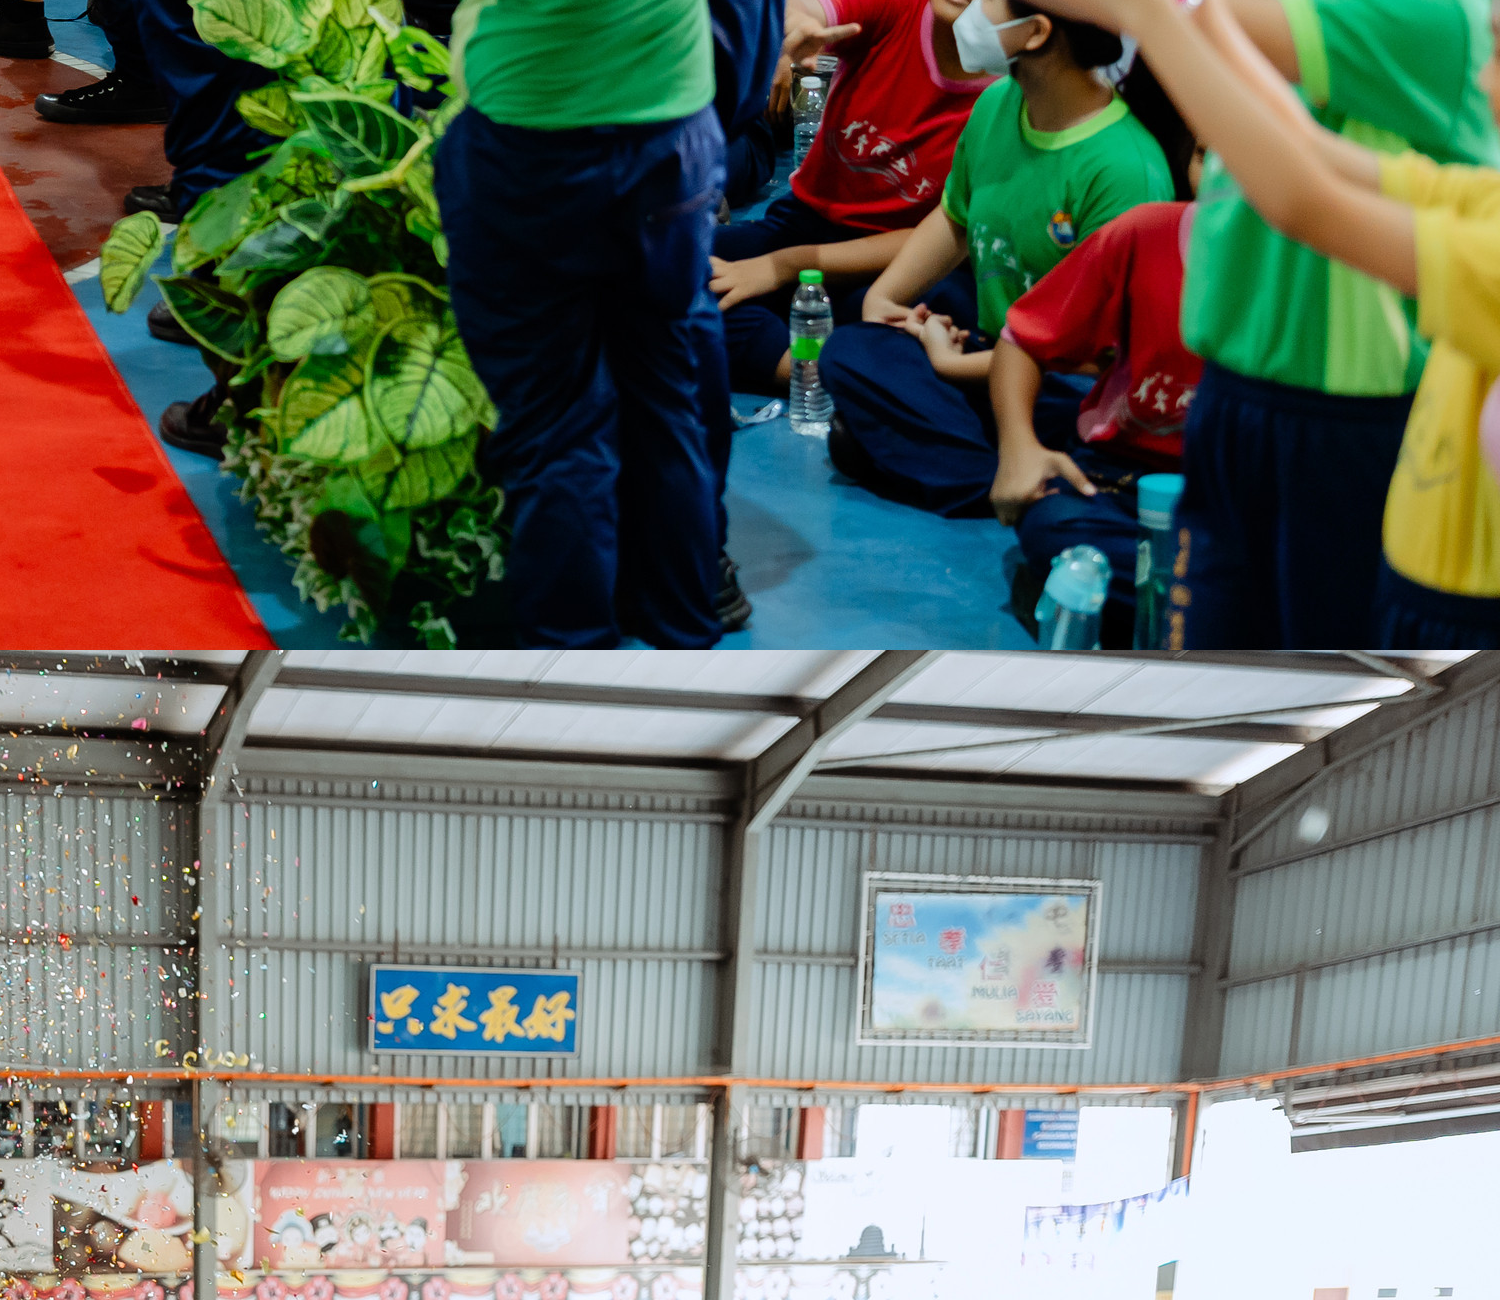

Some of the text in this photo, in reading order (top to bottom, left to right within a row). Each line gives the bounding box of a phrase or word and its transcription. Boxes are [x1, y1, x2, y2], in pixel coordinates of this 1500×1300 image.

[927, 956, 966, 969] TAAT
[971, 985, 1018, 1000] MULIA
[376, 982, 576, 1044] 只求最好
[1015, 1009, 1075, 1024] SAYANG
